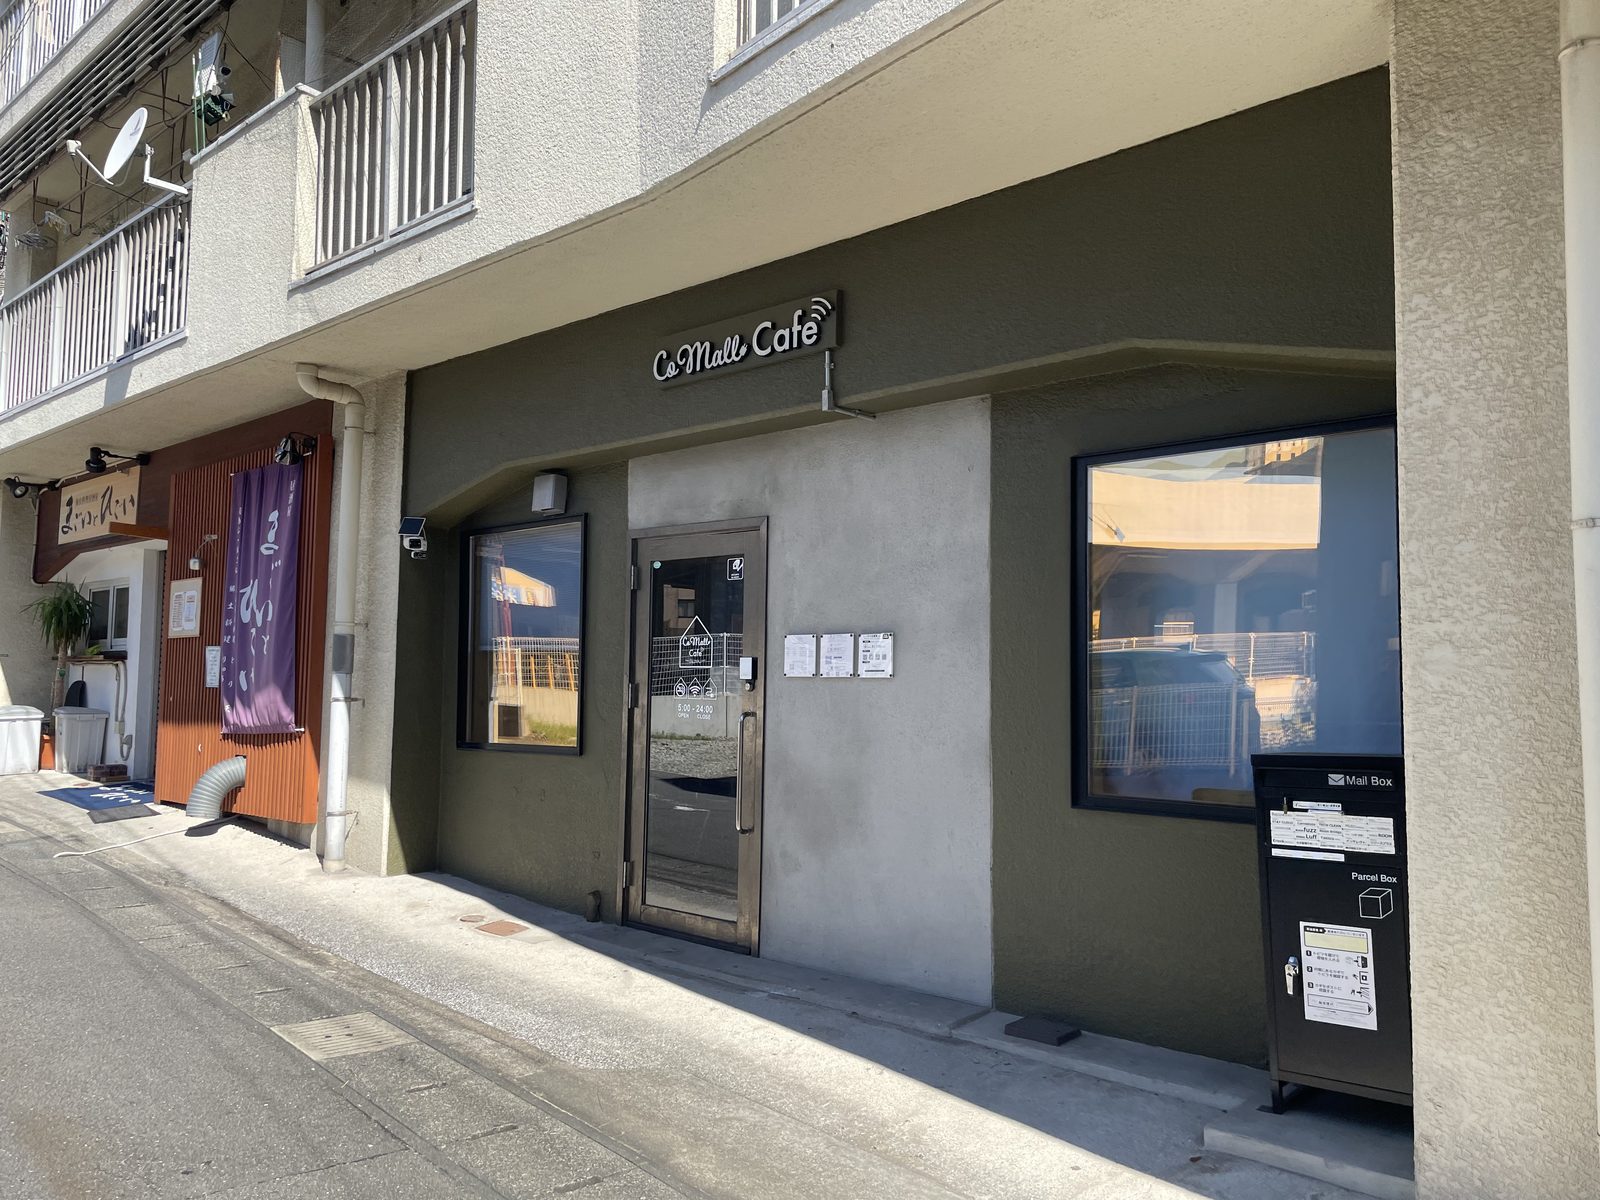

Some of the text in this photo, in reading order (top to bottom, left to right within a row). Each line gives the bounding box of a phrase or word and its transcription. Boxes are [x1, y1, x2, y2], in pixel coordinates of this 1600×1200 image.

[677, 703, 691, 712] 5:00
[695, 704, 713, 713] 24:00
[1346, 775, 1393, 786] Mail Box
[1351, 872, 1398, 884] Parcel Box
